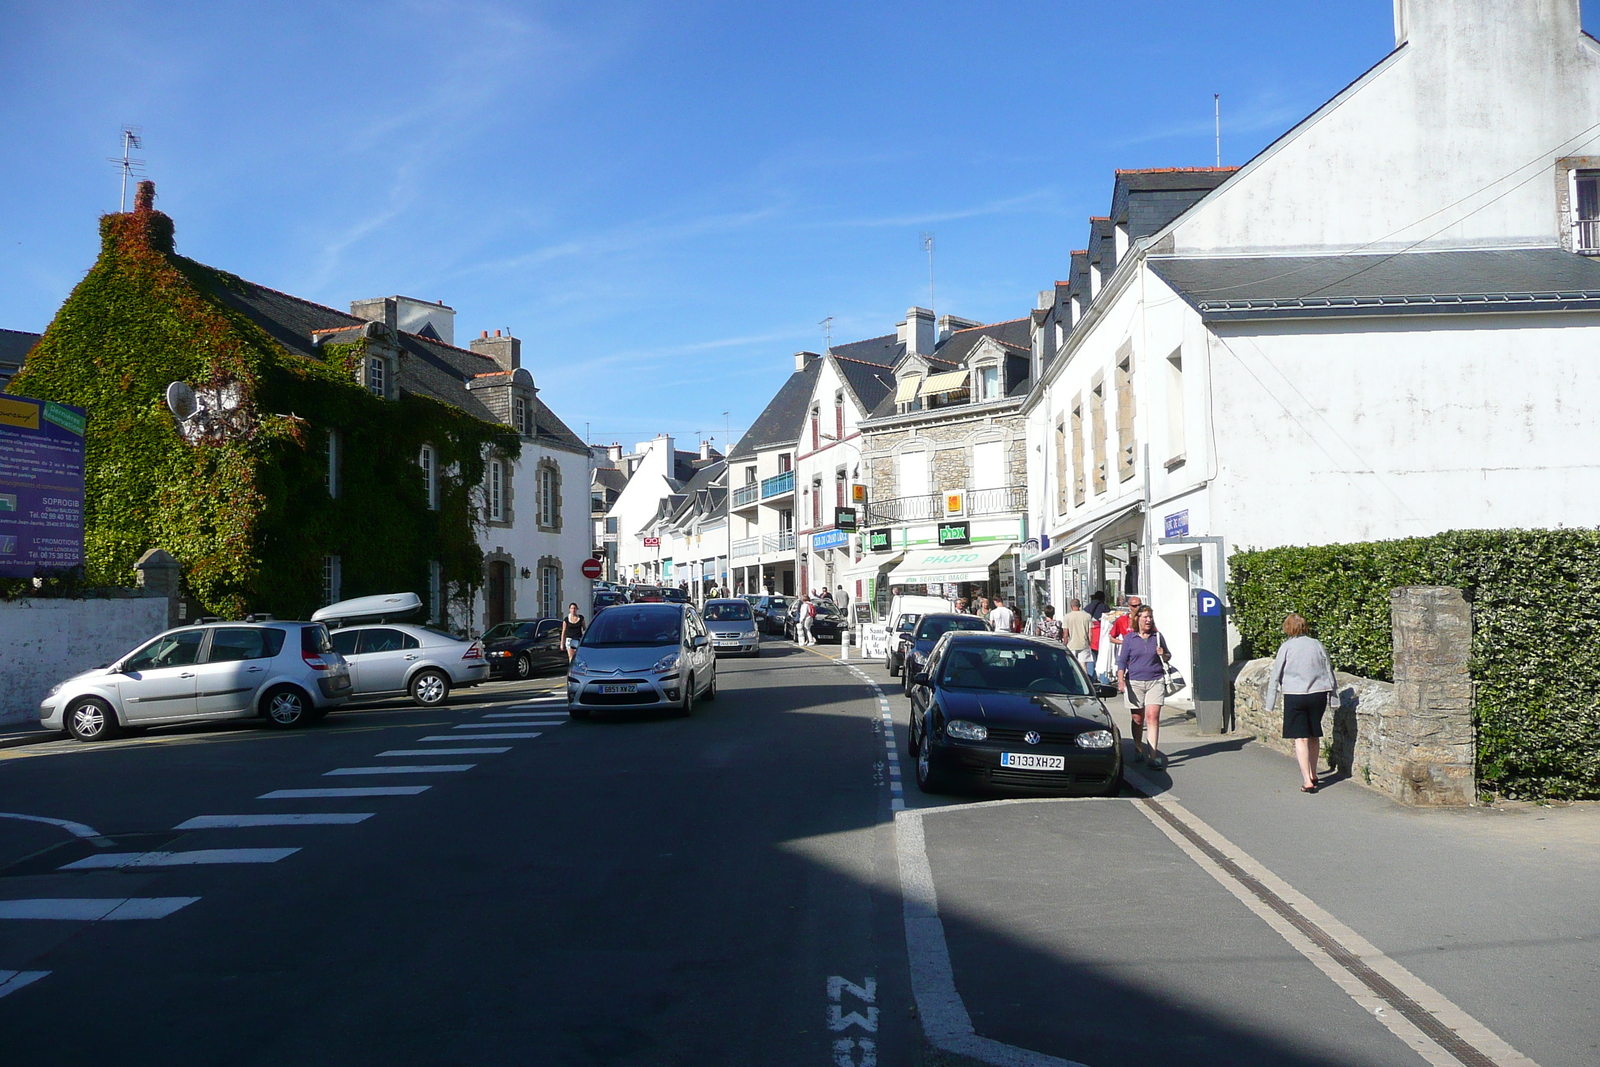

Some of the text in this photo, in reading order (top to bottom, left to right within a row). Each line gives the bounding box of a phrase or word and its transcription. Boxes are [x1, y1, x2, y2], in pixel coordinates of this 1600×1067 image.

[43, 409, 84, 434] Réservations
[50, 405, 80, 424] Dernières
[42, 497, 80, 507] SOPROGIB
[941, 525, 965, 542] phox
[922, 553, 978, 564] PHOTO
[1203, 598, 1215, 612] P
[1010, 755, 1061, 768] 9133 XH 22
